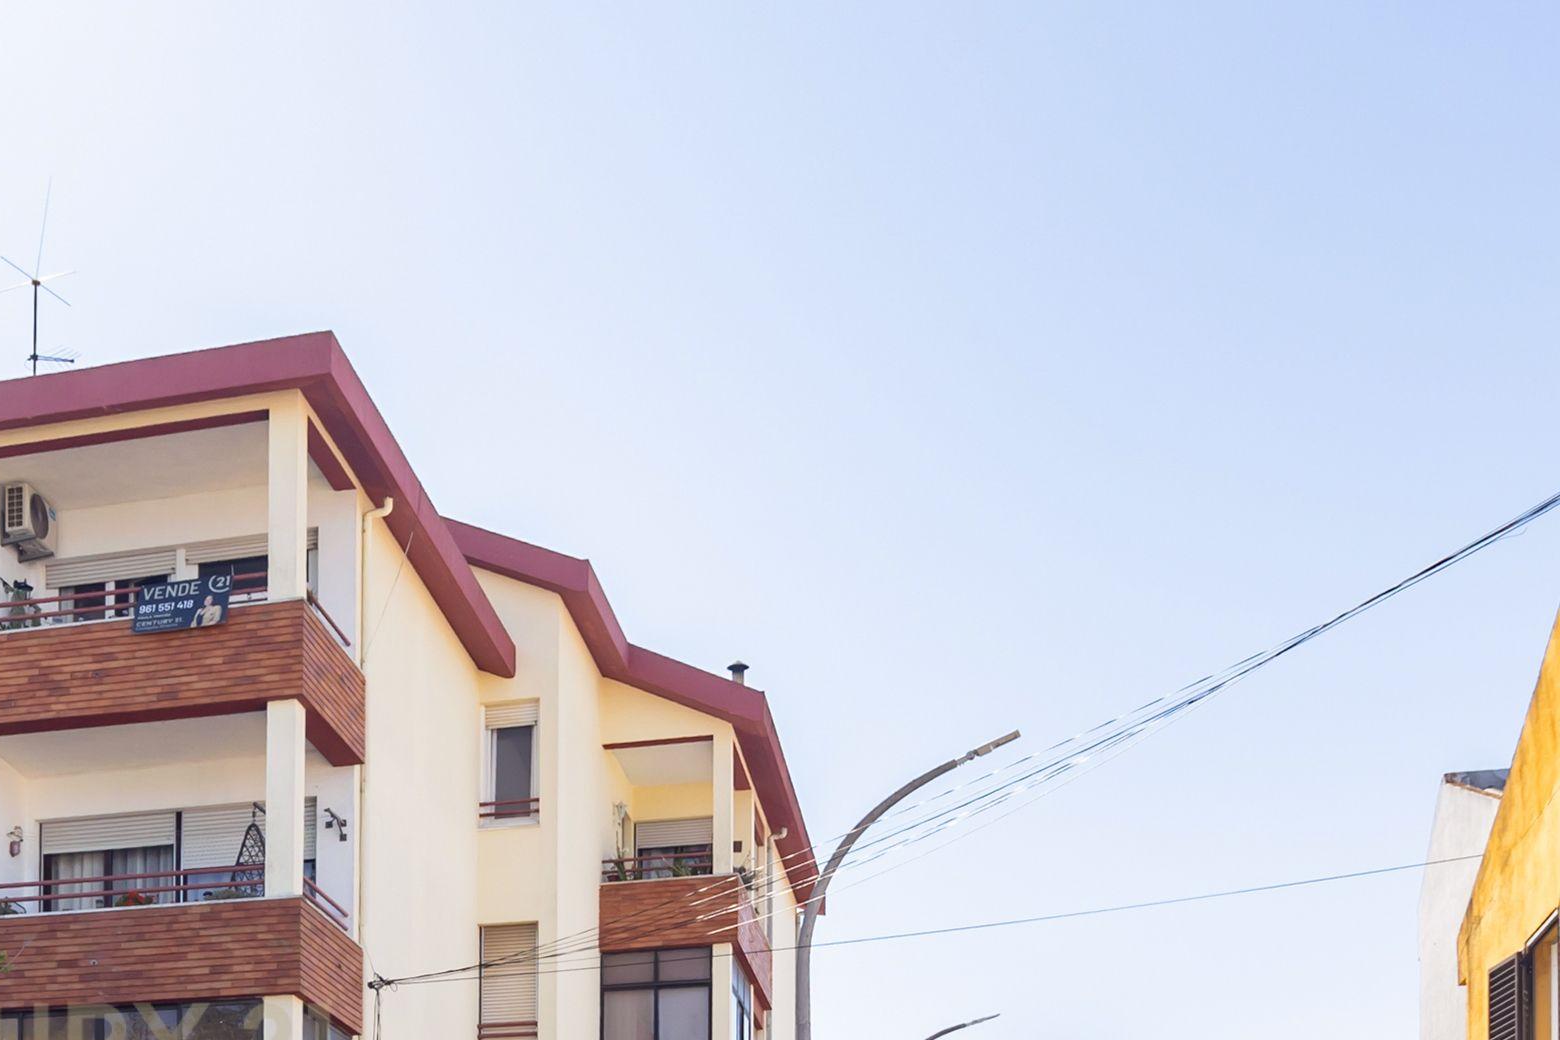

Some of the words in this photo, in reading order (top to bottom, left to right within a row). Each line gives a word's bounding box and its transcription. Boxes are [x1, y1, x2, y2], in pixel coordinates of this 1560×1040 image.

[144, 581, 202, 600] VENDE
[139, 604, 156, 614] 961
[158, 602, 175, 612] 551
[177, 600, 194, 609] 418
